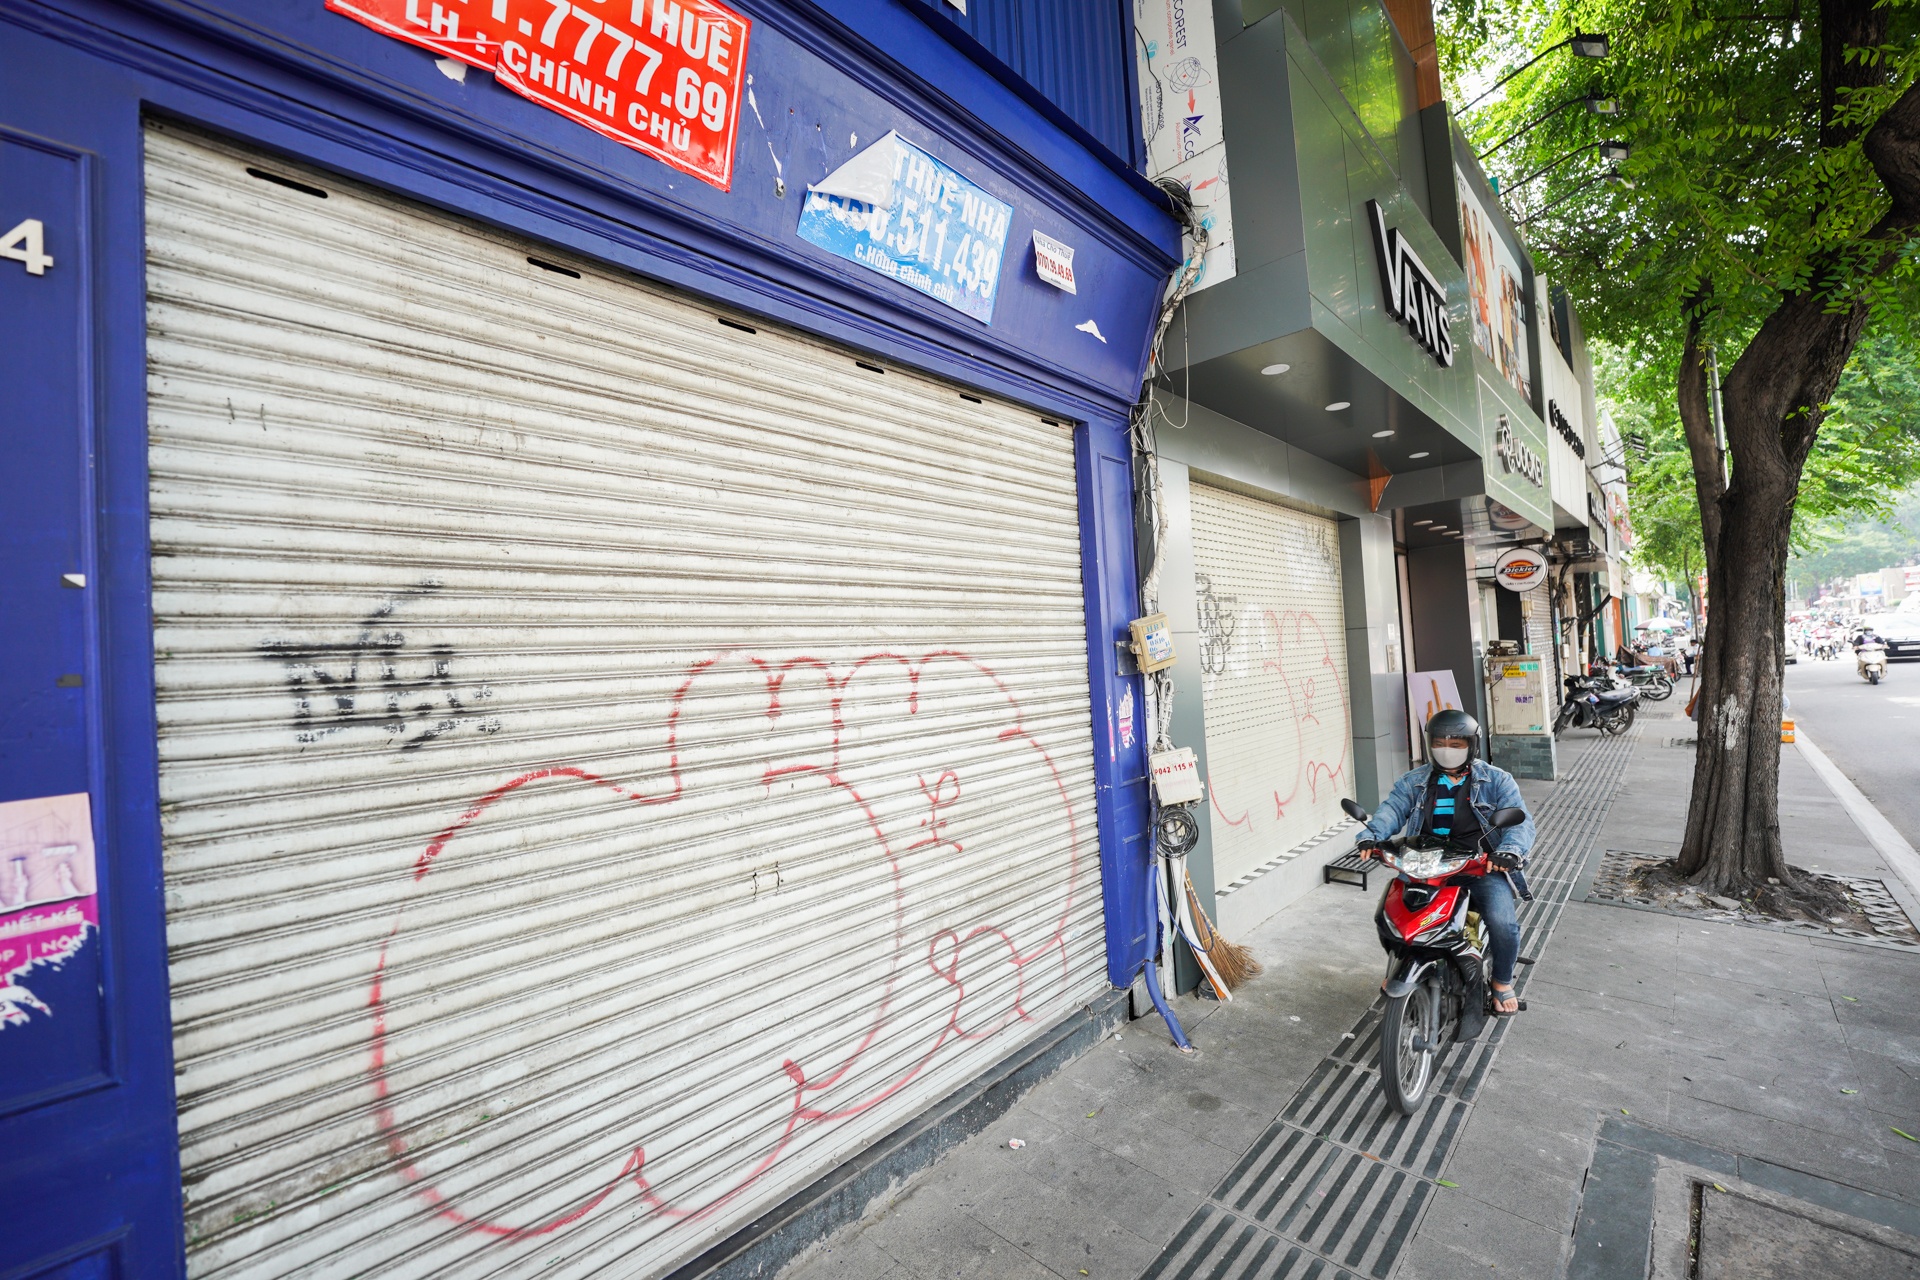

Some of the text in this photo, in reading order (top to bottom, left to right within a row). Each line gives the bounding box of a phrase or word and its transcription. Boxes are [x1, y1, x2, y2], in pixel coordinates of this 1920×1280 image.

[503, 40, 616, 118] CHÍNH
[627, 106, 691, 152] CHỦ
[893, 146, 1007, 246] THUÊ NHÀ
[1366, 199, 1453, 369] VANS
[1503, 566, 1538, 574] Dickies
